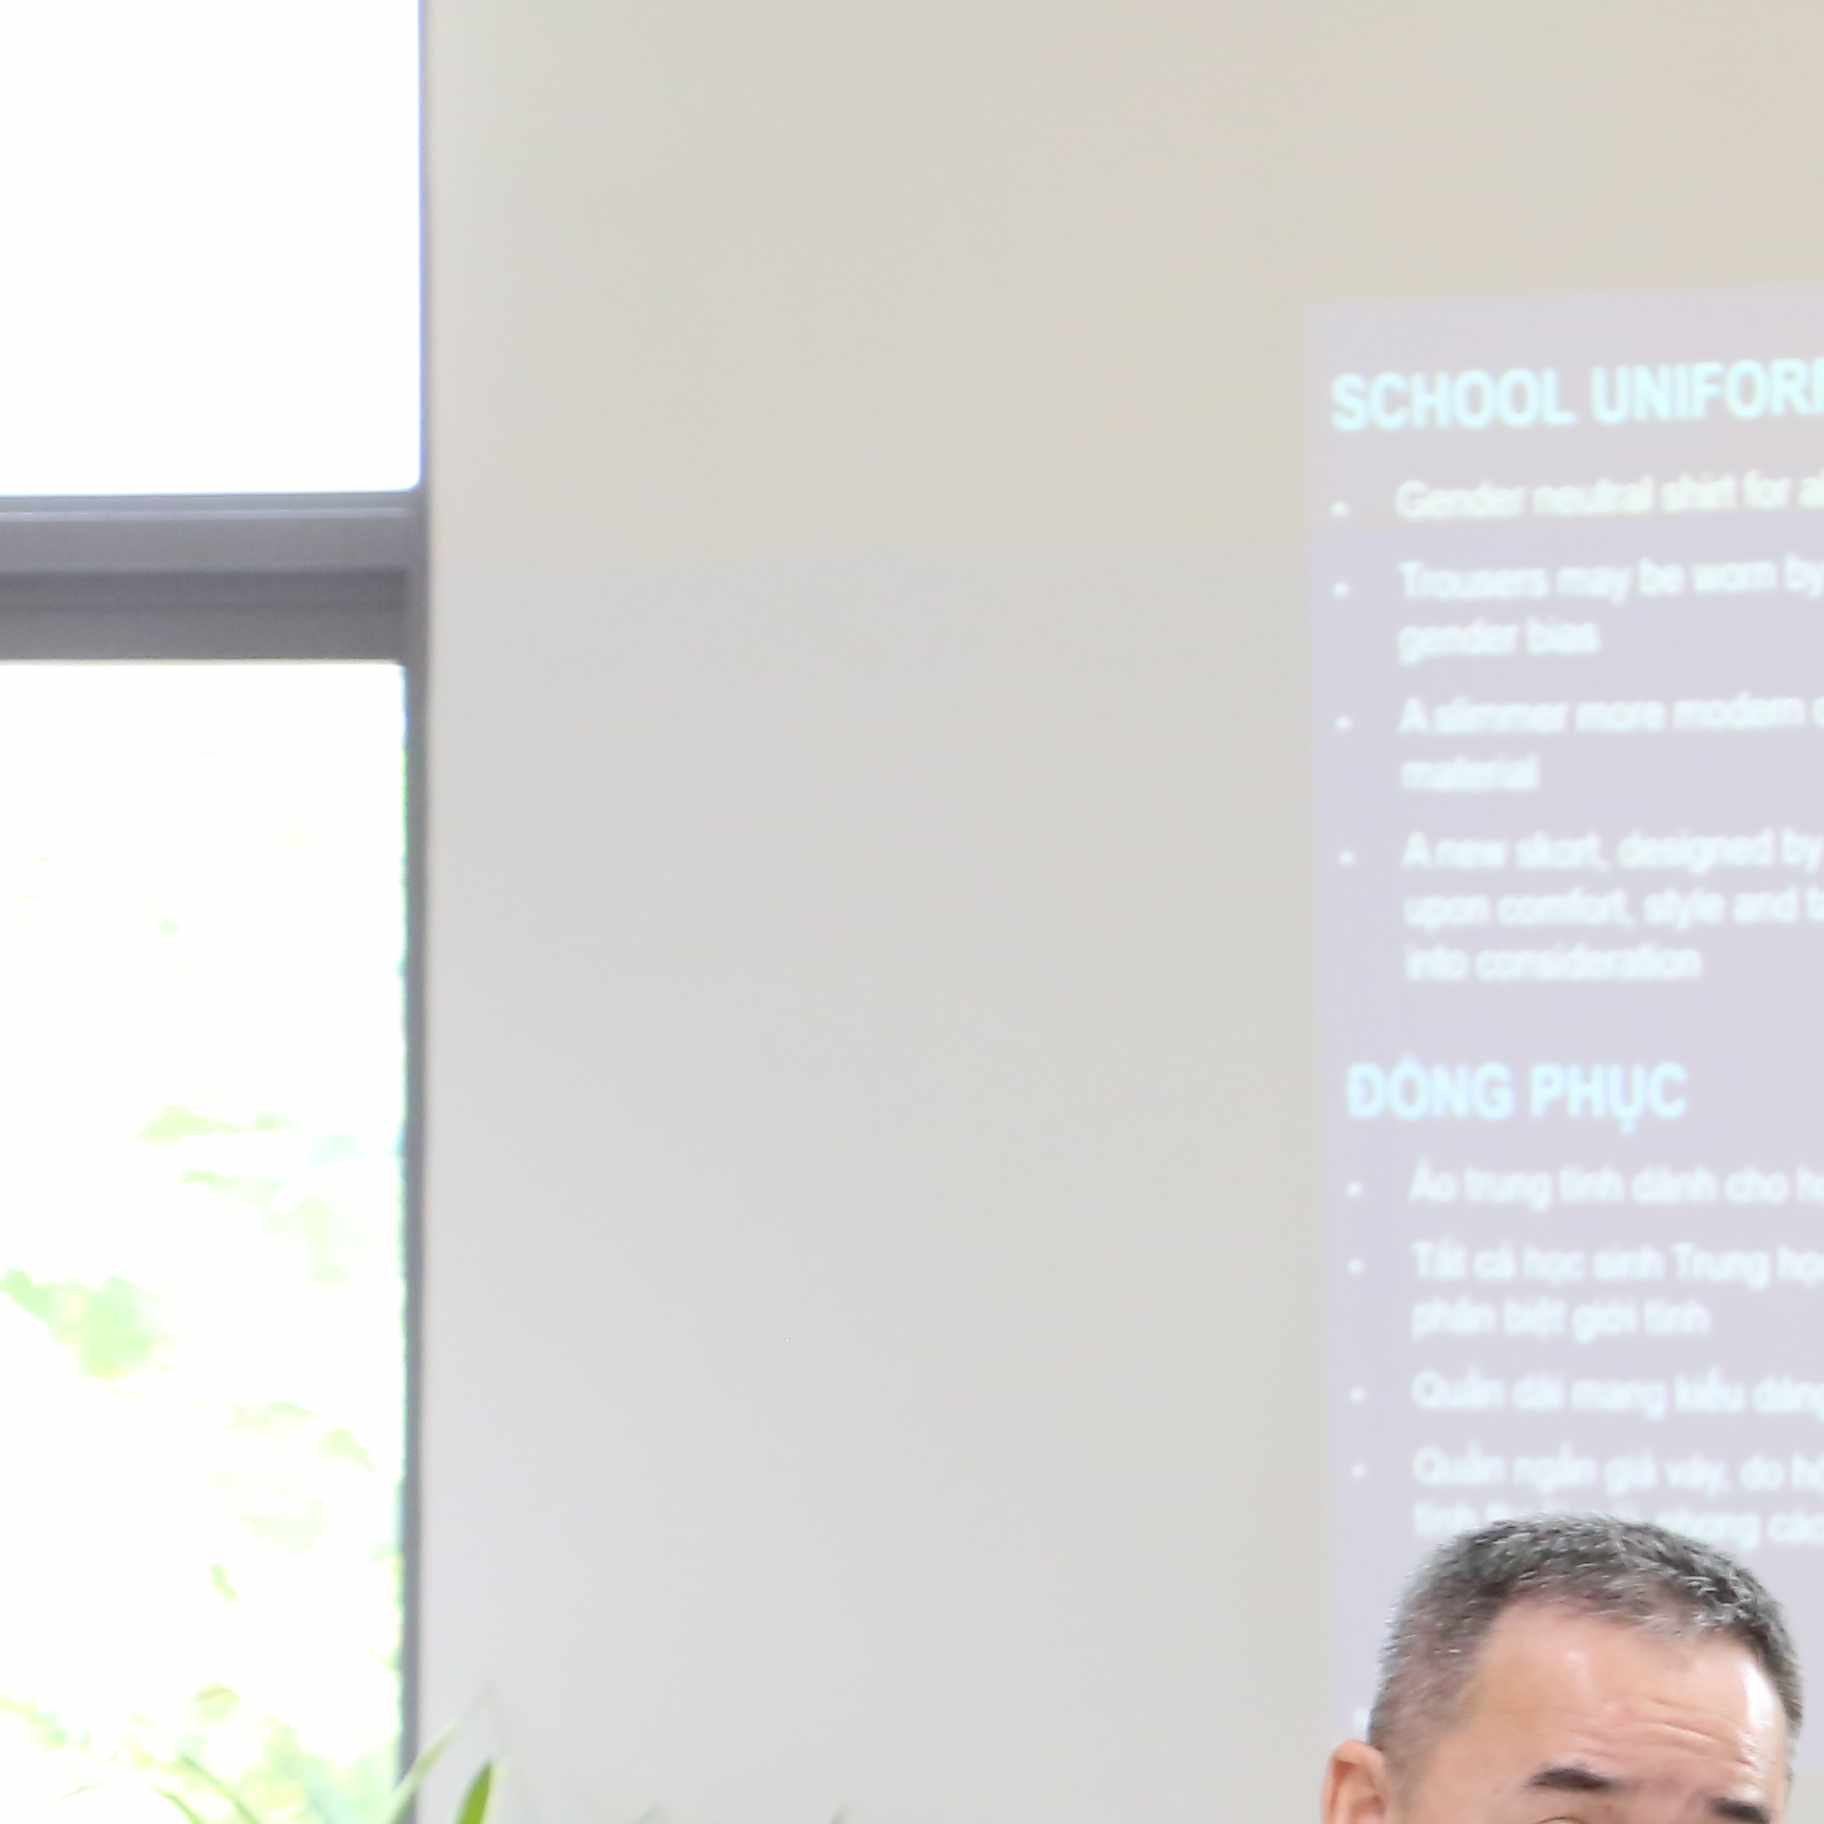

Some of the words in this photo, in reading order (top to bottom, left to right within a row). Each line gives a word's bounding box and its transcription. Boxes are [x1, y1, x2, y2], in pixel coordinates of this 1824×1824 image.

[1331, 368, 1576, 432] SCHOOL
[1395, 480, 1525, 520] Gender
[1533, 477, 1655, 516] neutral
[1661, 475, 1736, 512] shirt
[1743, 470, 1790, 510] for
[1399, 561, 1550, 601] Trousers
[1557, 567, 1631, 602] may
[1638, 559, 1685, 596] be
[1692, 561, 1777, 593] worn
[1398, 620, 1519, 664] gender
[1526, 618, 1600, 655] bias
[1399, 698, 1432, 733] A
[1431, 697, 1568, 734] slimmer
[1576, 701, 1666, 732] more
[1673, 693, 1806, 730] modern
[1402, 756, 1538, 792] material
[1402, 832, 1433, 867] A
[1432, 840, 1507, 869] new
[1617, 829, 1775, 870] designed
[1781, 829, 1824, 869] by
[1404, 896, 1490, 931] upon
[1497, 887, 1633, 926] comfort,
[1643, 889, 1725, 930] style
[1733, 886, 1798, 923] and
[1405, 946, 1470, 981] into
[1475, 944, 1702, 981] consideration
[1529, 1061, 1687, 1133] PHỤC
